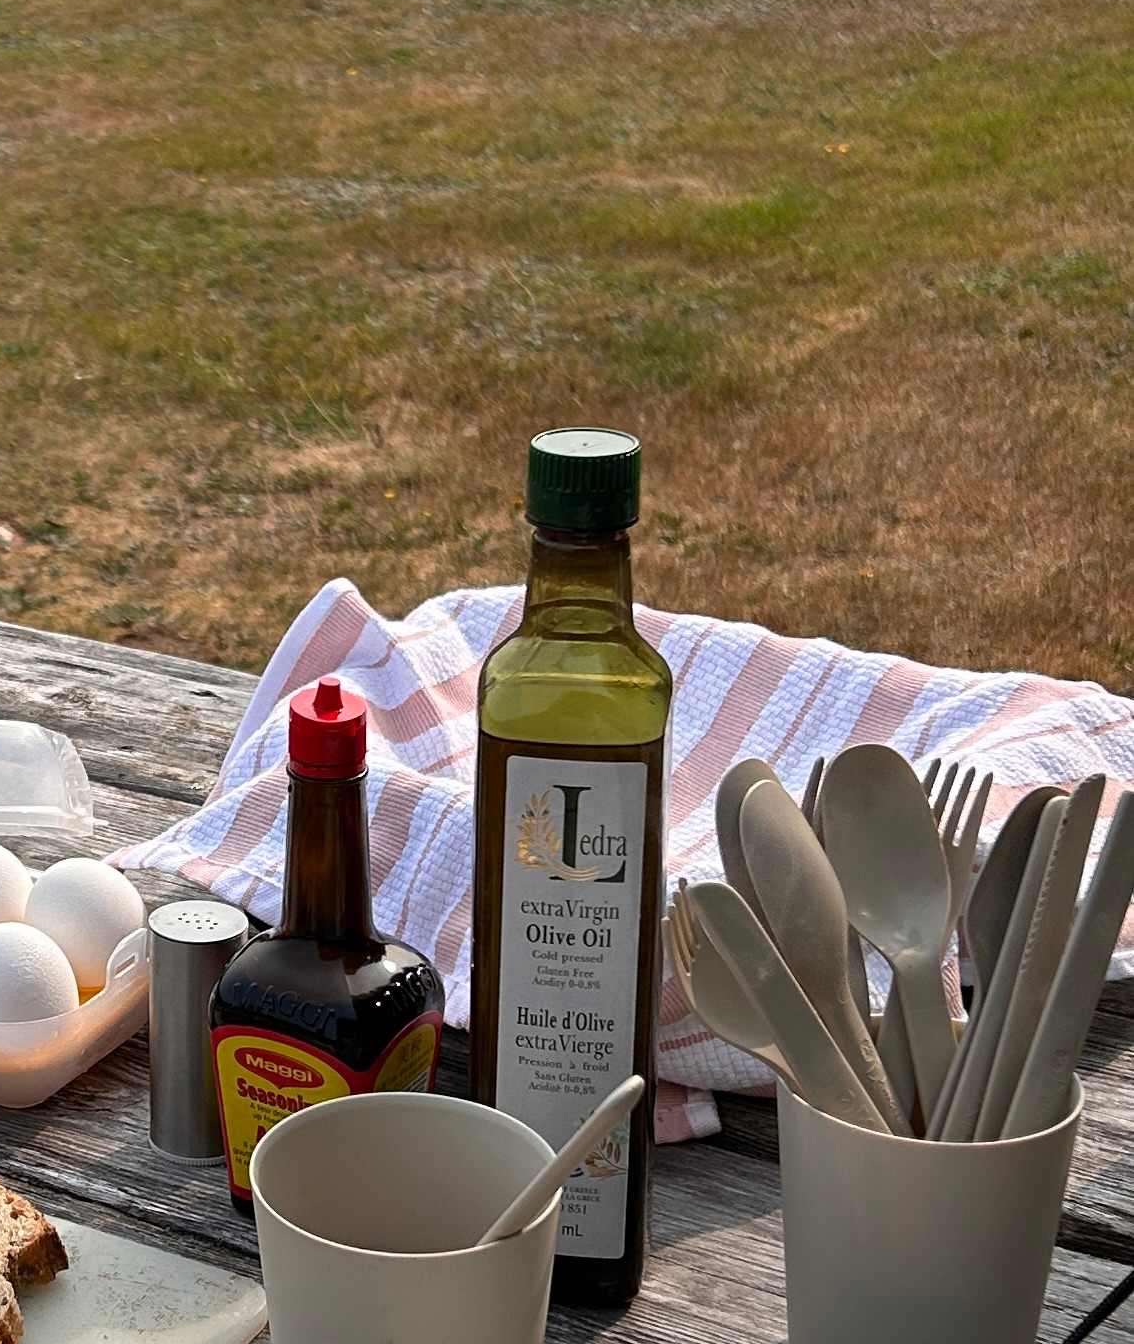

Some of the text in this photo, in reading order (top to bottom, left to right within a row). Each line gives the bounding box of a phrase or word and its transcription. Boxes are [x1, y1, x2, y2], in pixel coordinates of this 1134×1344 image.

[548, 785, 627, 883] Ledra
[526, 923, 612, 948] Olive Oil
[532, 949, 604, 964] Cold pressed
[537, 965, 595, 978] Gluten Free
[532, 976, 566, 990] Acidity
[517, 1006, 614, 1032] Huile d'Olive
[245, 1053, 313, 1083] Maggi
[518, 1056, 610, 1072] Pression à froid
[535, 1070, 556, 1081] Sans
[561, 1224, 584, 1237] mL
